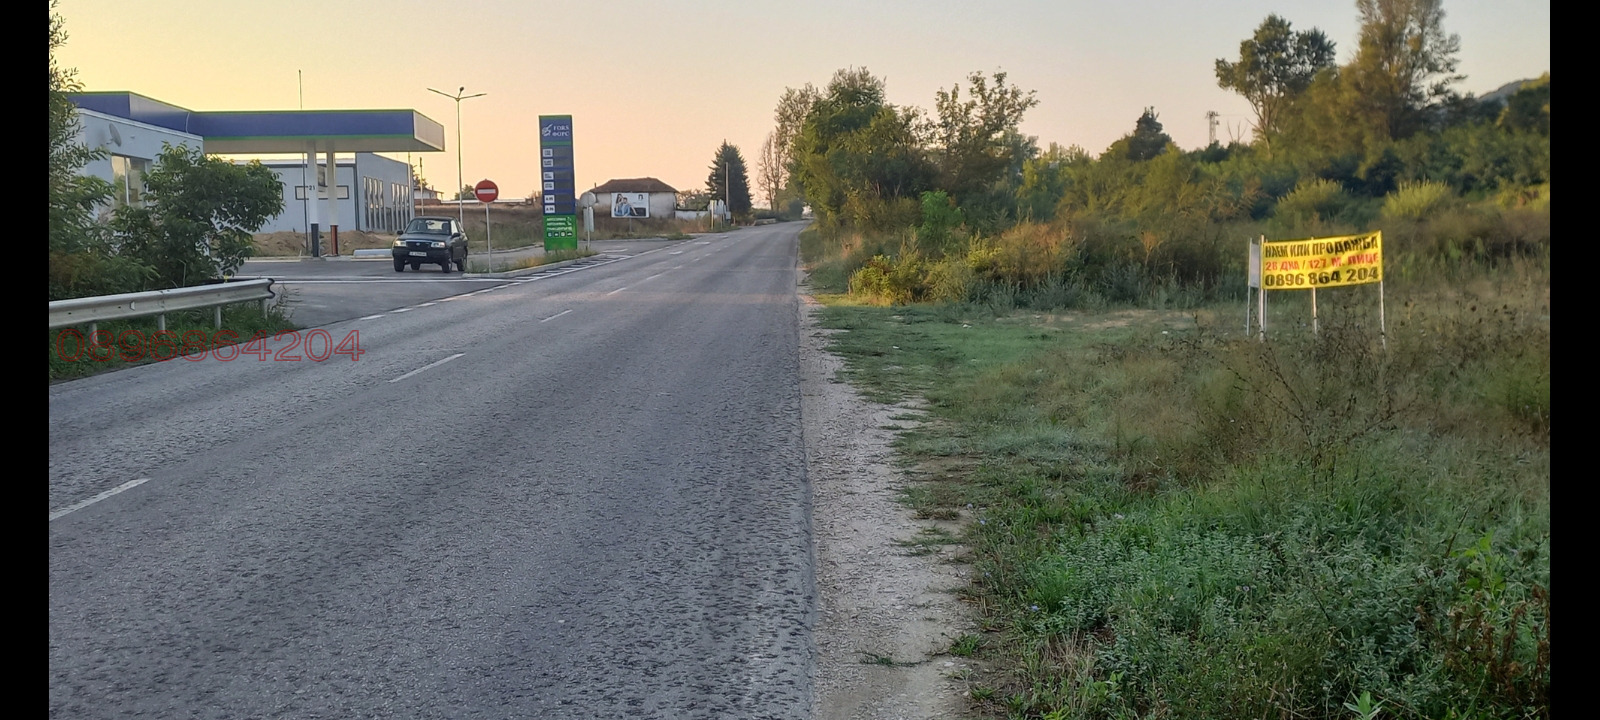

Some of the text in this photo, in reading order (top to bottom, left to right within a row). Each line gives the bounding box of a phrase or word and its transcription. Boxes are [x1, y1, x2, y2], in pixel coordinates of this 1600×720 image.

[1265, 236, 1379, 258] НАЕМ ИЛИ ПРОДАЖБА
[1309, 258, 1327, 269] 127
[1347, 252, 1379, 265] ЛИЦЕ
[1265, 267, 1379, 286] 0896 864 204
